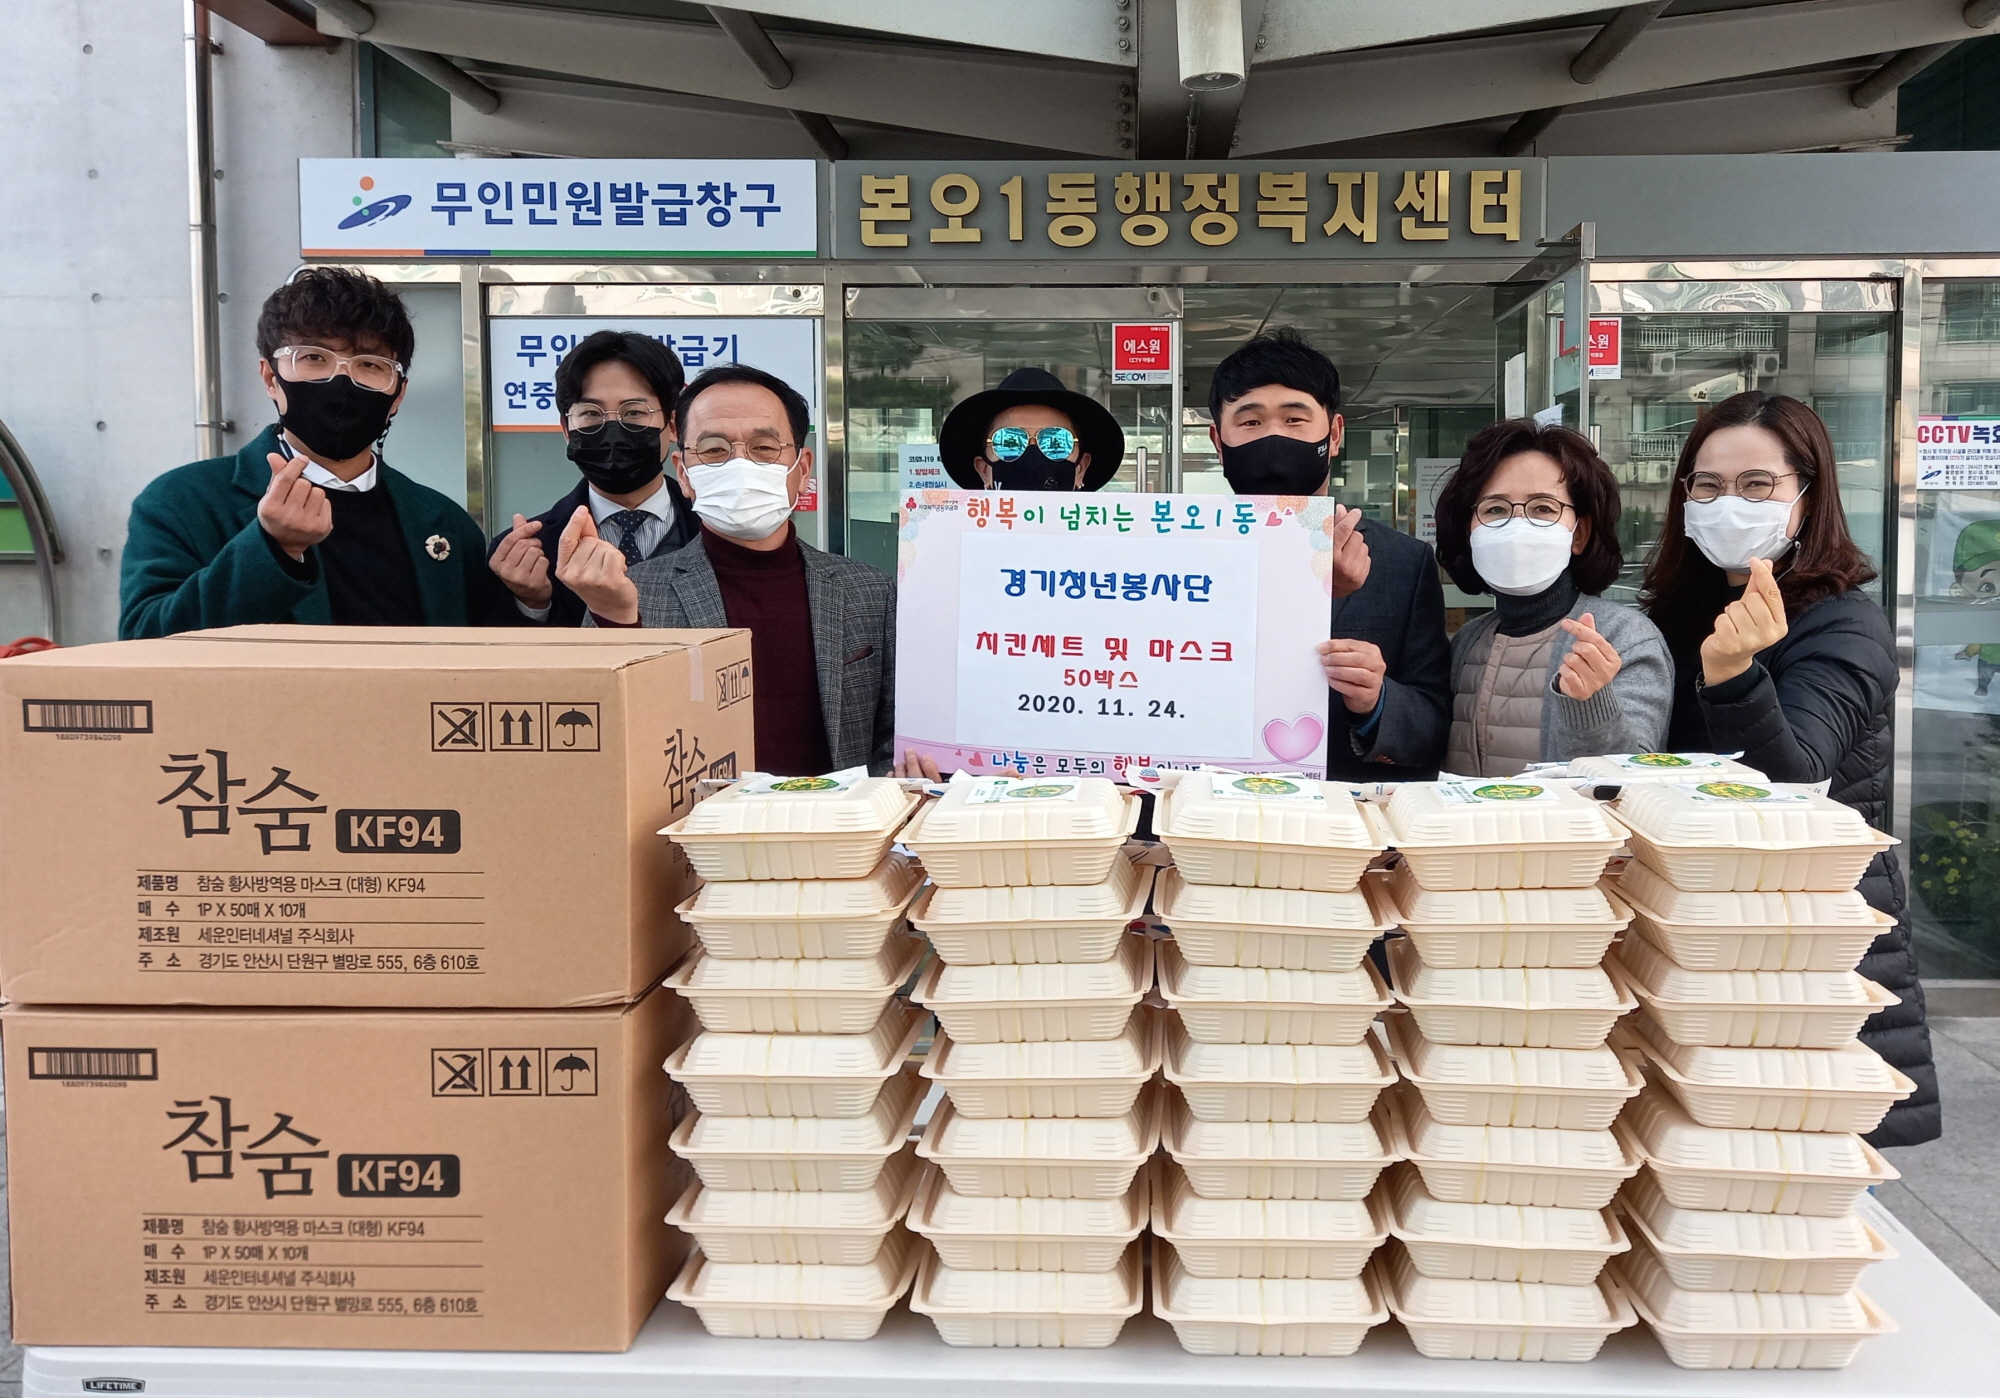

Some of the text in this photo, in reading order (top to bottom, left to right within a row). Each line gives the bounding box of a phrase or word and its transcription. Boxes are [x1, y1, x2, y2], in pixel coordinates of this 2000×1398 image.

[431, 181, 781, 228] 무인민원발급창구
[859, 169, 1522, 248] 본오1동행정복지센터
[517, 334, 738, 367] 무인급기
[1123, 339, 1160, 354] 에스원
[1589, 334, 1609, 349] 스원
[1115, 373, 1146, 381] SECOM
[504, 381, 555, 410] 연중
[967, 497, 1044, 529] 행복이
[1060, 503, 1134, 532] 넘치는
[1000, 568, 1213, 603] 경기청년봉사단
[976, 631, 1233, 662] 치킨세트 및 마스크
[1063, 668, 1139, 689] 50박스
[1018, 693, 1185, 718] 2020. 11. 24.
[56, 733, 122, 741] 18809739840098
[992, 750, 1047, 774] 나눔은
[1055, 758, 1105, 774] 모두의
[157, 748, 444, 855] 참숨 KF94
[137, 875, 425, 893] 제품명 참숨 황사방역용 마스크 (대형) KF94
[197, 903, 212, 916] 1P
[230, 902, 259, 918] 50매
[278, 902, 306, 918] 10개
[138, 926, 354, 944] 제조원 세운인터네셔널 주식회사
[199, 953, 239, 969] 경기도
[243, 953, 283, 970] 안산시
[287, 953, 329, 970] 단원구
[333, 953, 373, 970] 별망로
[377, 955, 408, 972] 555,
[413, 954, 437, 970] 6층
[441, 954, 480, 970] 610호
[162, 1095, 444, 1200] 참숨 KF94
[143, 1218, 425, 1237] 제품명 참숨 황사방역용 마스크 (대형) KF94
[202, 1246, 217, 1259] 1P
[234, 1245, 264, 1260] 50매
[282, 1245, 309, 1261] 10개
[144, 1268, 356, 1287] 제조원 세운인터네셔널 주식회사
[205, 1294, 244, 1311] 경기도
[247, 1295, 287, 1311] 안산시
[290, 1296, 331, 1312] 단원구
[377, 1297, 408, 1315] 555,
[413, 1297, 436, 1313] 6층
[440, 1297, 478, 1313] 610호
[90, 1382, 138, 1390] LIFETIME
